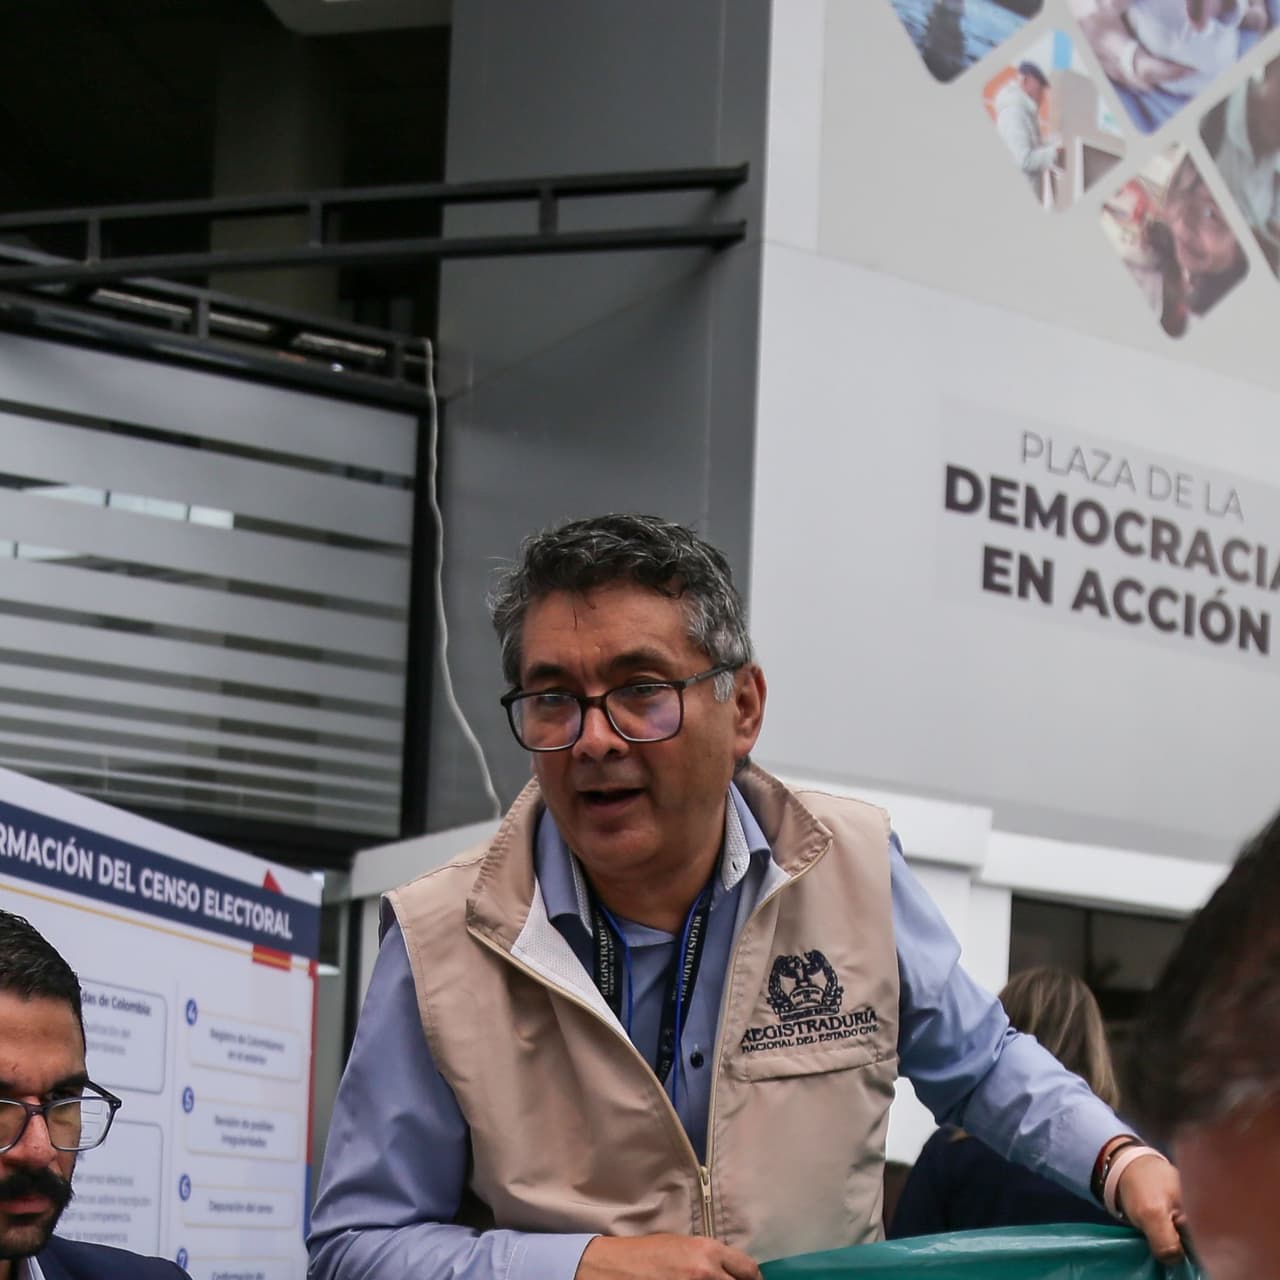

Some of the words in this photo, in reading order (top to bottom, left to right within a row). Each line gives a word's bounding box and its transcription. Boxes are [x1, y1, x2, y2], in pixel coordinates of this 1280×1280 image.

[1021, 431, 1137, 493] PLAZA
[1148, 464, 1193, 509] DE
[1204, 481, 1245, 522] LA
[982, 544, 1054, 605] EN
[1071, 567, 1271, 655] ACCIÓN
[98, 856, 136, 893] DEL
[140, 868, 200, 912] CENSO
[203, 888, 293, 940] ELECTORAL
[741, 1040, 795, 1054] NACIONAL
[796, 1035, 818, 1047] DEL
[819, 1029, 859, 1042] ESTADO
